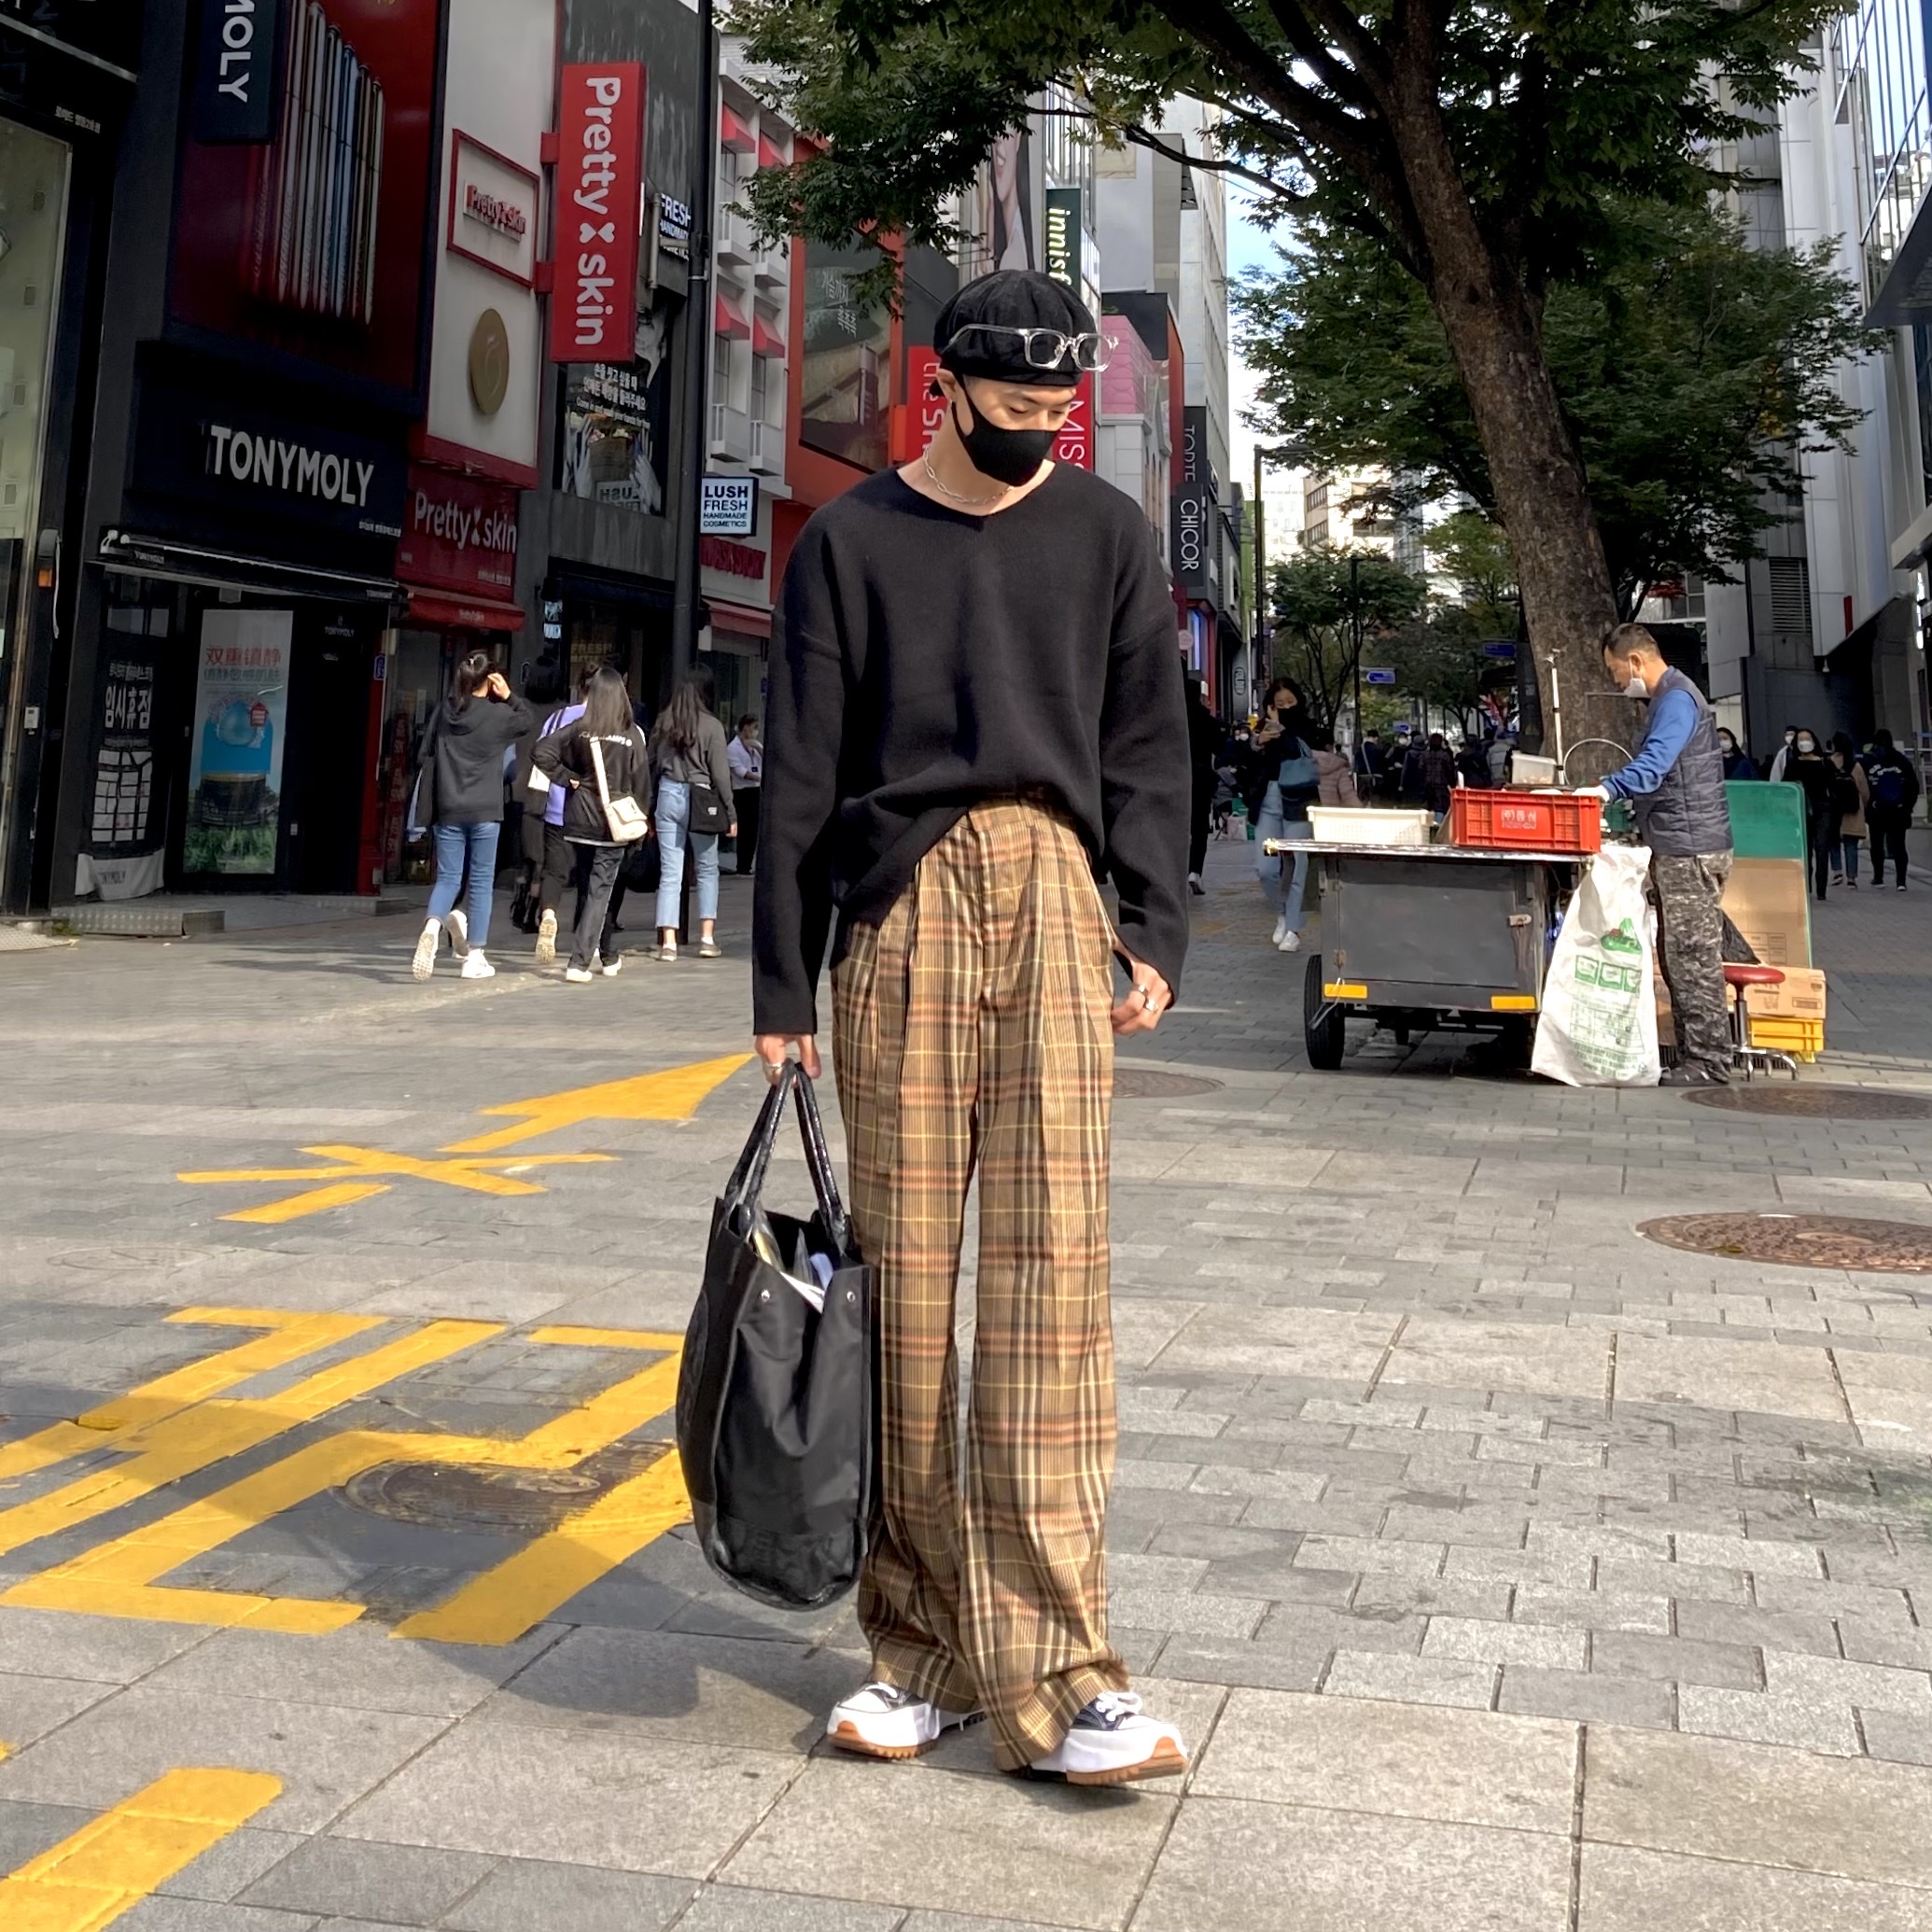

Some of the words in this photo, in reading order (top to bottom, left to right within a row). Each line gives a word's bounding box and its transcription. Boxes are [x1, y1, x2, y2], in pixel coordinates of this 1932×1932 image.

[573, 77, 622, 215] Pretty
[574, 253, 614, 345] skin
[210, 424, 374, 507] TONYMOLY
[704, 485, 749, 498] LUSH
[414, 490, 471, 551] Pretty
[483, 510, 517, 554] skin
[703, 520, 748, 528] COSMETICS
[704, 499, 748, 511] FRESH
[1180, 498, 1199, 571] CHICOR
